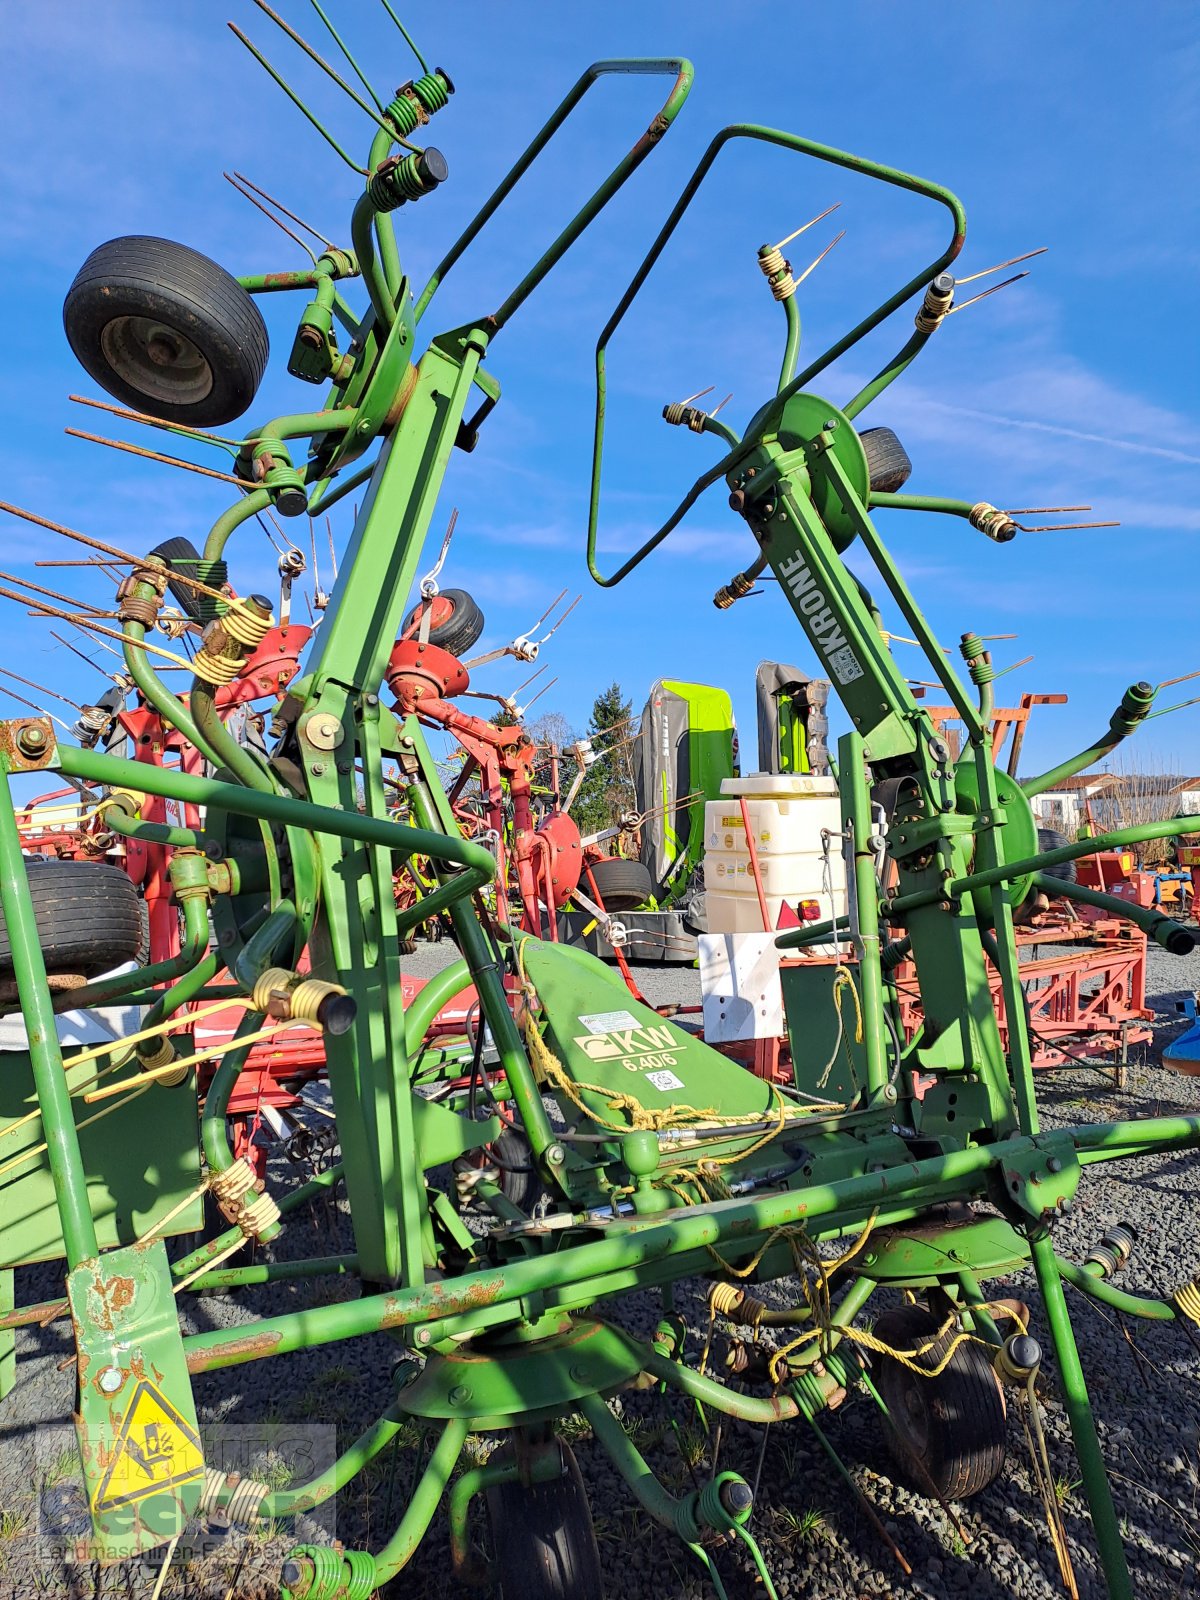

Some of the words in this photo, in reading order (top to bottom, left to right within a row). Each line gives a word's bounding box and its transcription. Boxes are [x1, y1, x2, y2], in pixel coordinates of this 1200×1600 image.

[778, 549, 848, 656] KRONE
[611, 1025, 678, 1053] KW
[622, 1053, 678, 1072] 6.40/6
